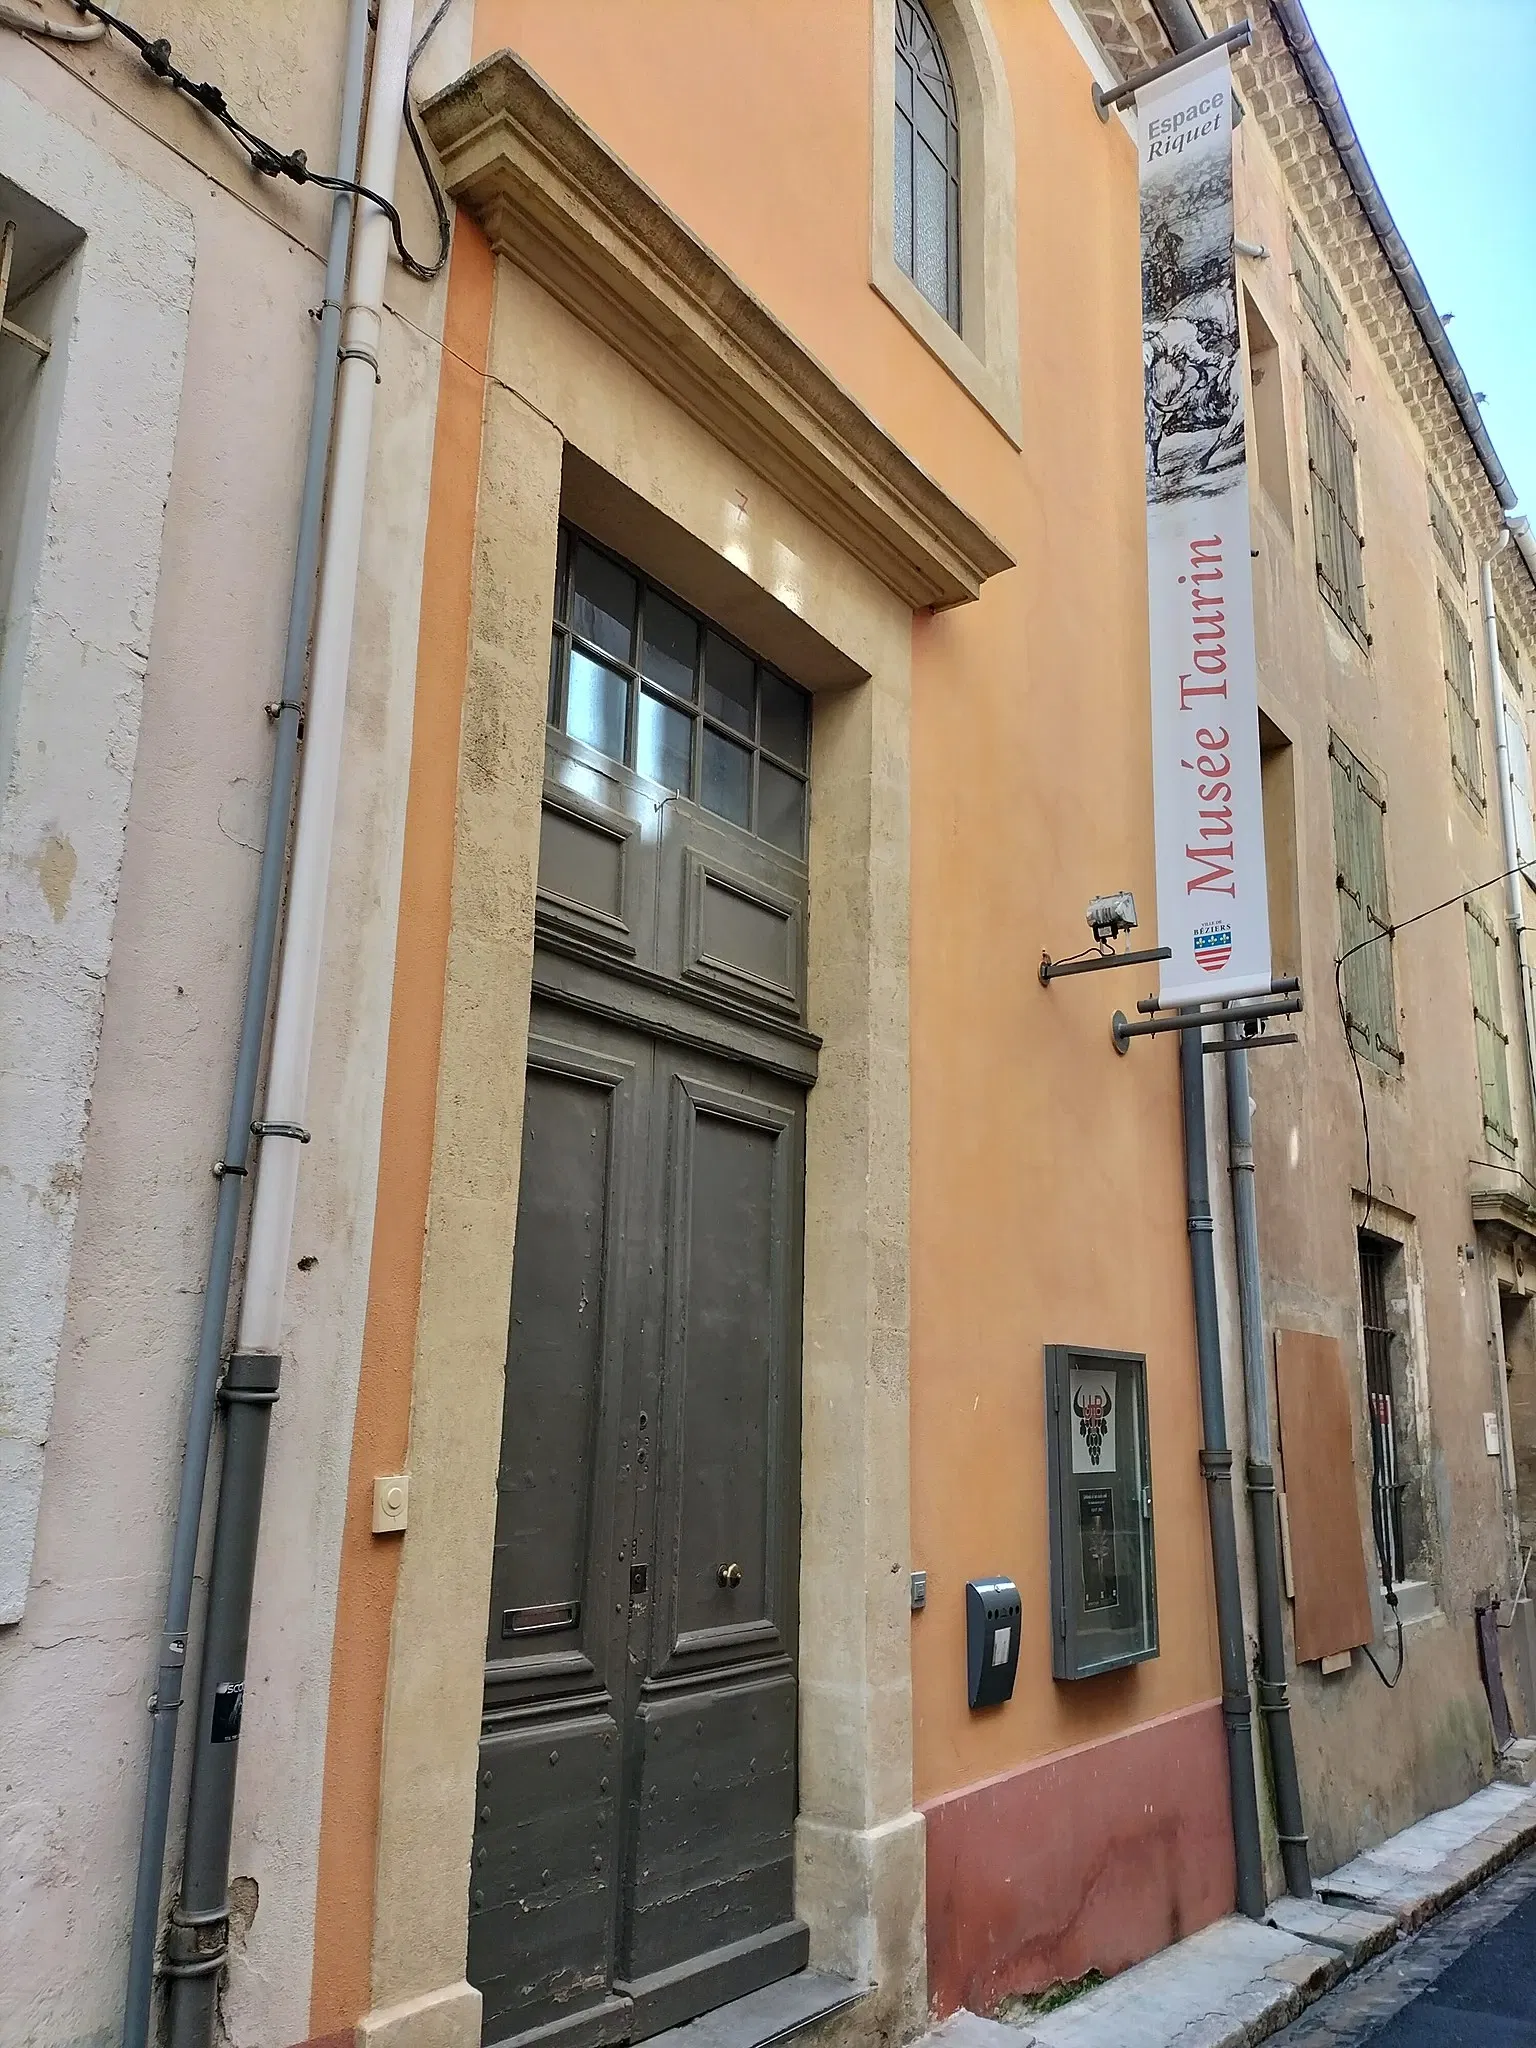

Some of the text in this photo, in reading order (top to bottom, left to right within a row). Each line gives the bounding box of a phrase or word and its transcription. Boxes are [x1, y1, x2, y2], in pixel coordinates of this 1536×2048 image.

[1147, 113, 1222, 163] Riquet
[1148, 92, 1224, 141] Espace
[1178, 534, 1235, 899] Musée Taurin
[1193, 924, 1231, 935] BÉZIERS
